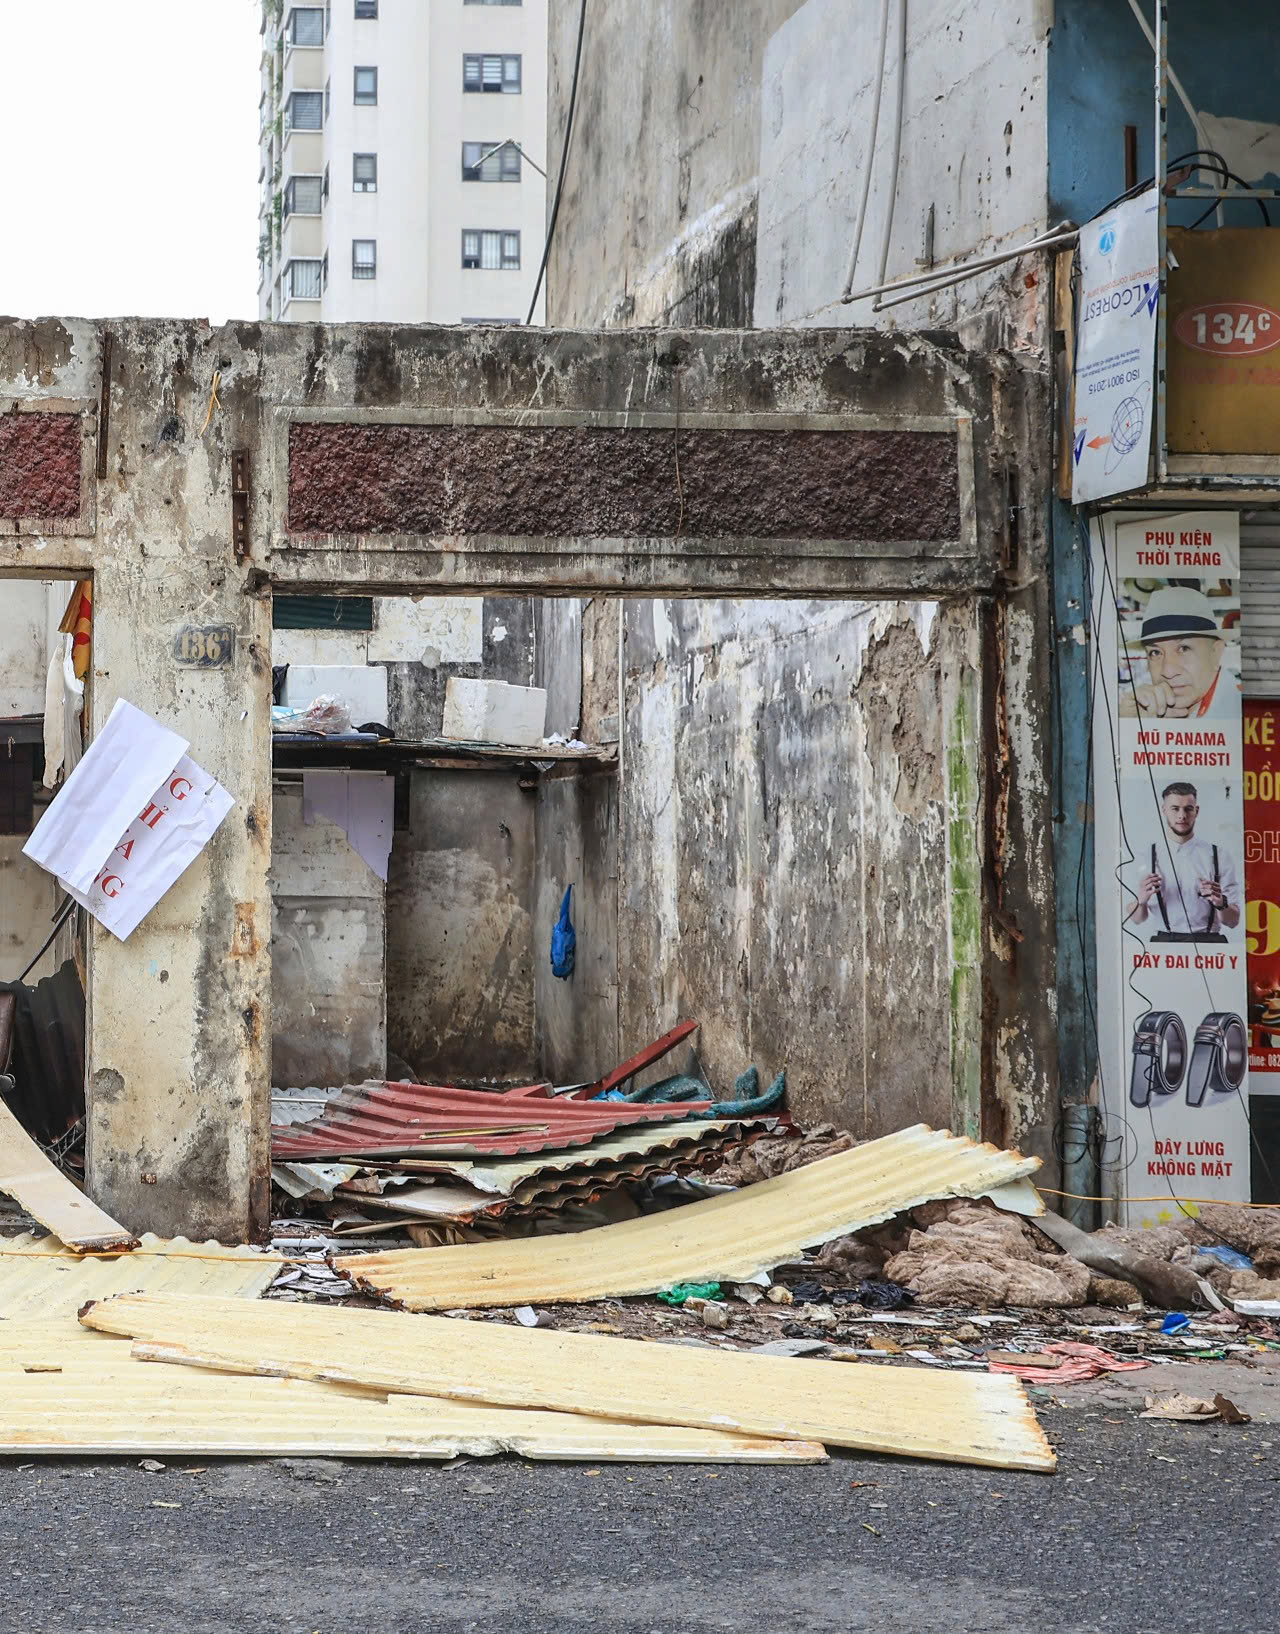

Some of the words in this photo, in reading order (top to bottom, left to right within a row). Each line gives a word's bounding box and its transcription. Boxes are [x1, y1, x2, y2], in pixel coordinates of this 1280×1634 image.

[1083, 282, 1159, 322] ALCOREST
[1088, 373, 1125, 395] 9001:2015
[1125, 368, 1140, 383] ISO
[1145, 531, 1175, 549] PHỤ
[1180, 529, 1212, 549] KIỆN
[1136, 548, 1170, 565] THỜI
[1174, 551, 1221, 566] TRANG
[1137, 728, 1160, 746] MŨ
[1165, 731, 1226, 746] PANAMA
[1244, 712, 1276, 752] KỆ
[1133, 751, 1230, 767] MONTECRISTI
[1133, 951, 1161, 968] DÂY
[1165, 954, 1190, 969] ĐAI
[1195, 952, 1225, 970] CHỮ
[1229, 955, 1238, 970] Y
[1187, 1139, 1224, 1156] LƯNG
[1147, 1158, 1196, 1176] KHÔNG
[1201, 1160, 1233, 1180] MẶT
